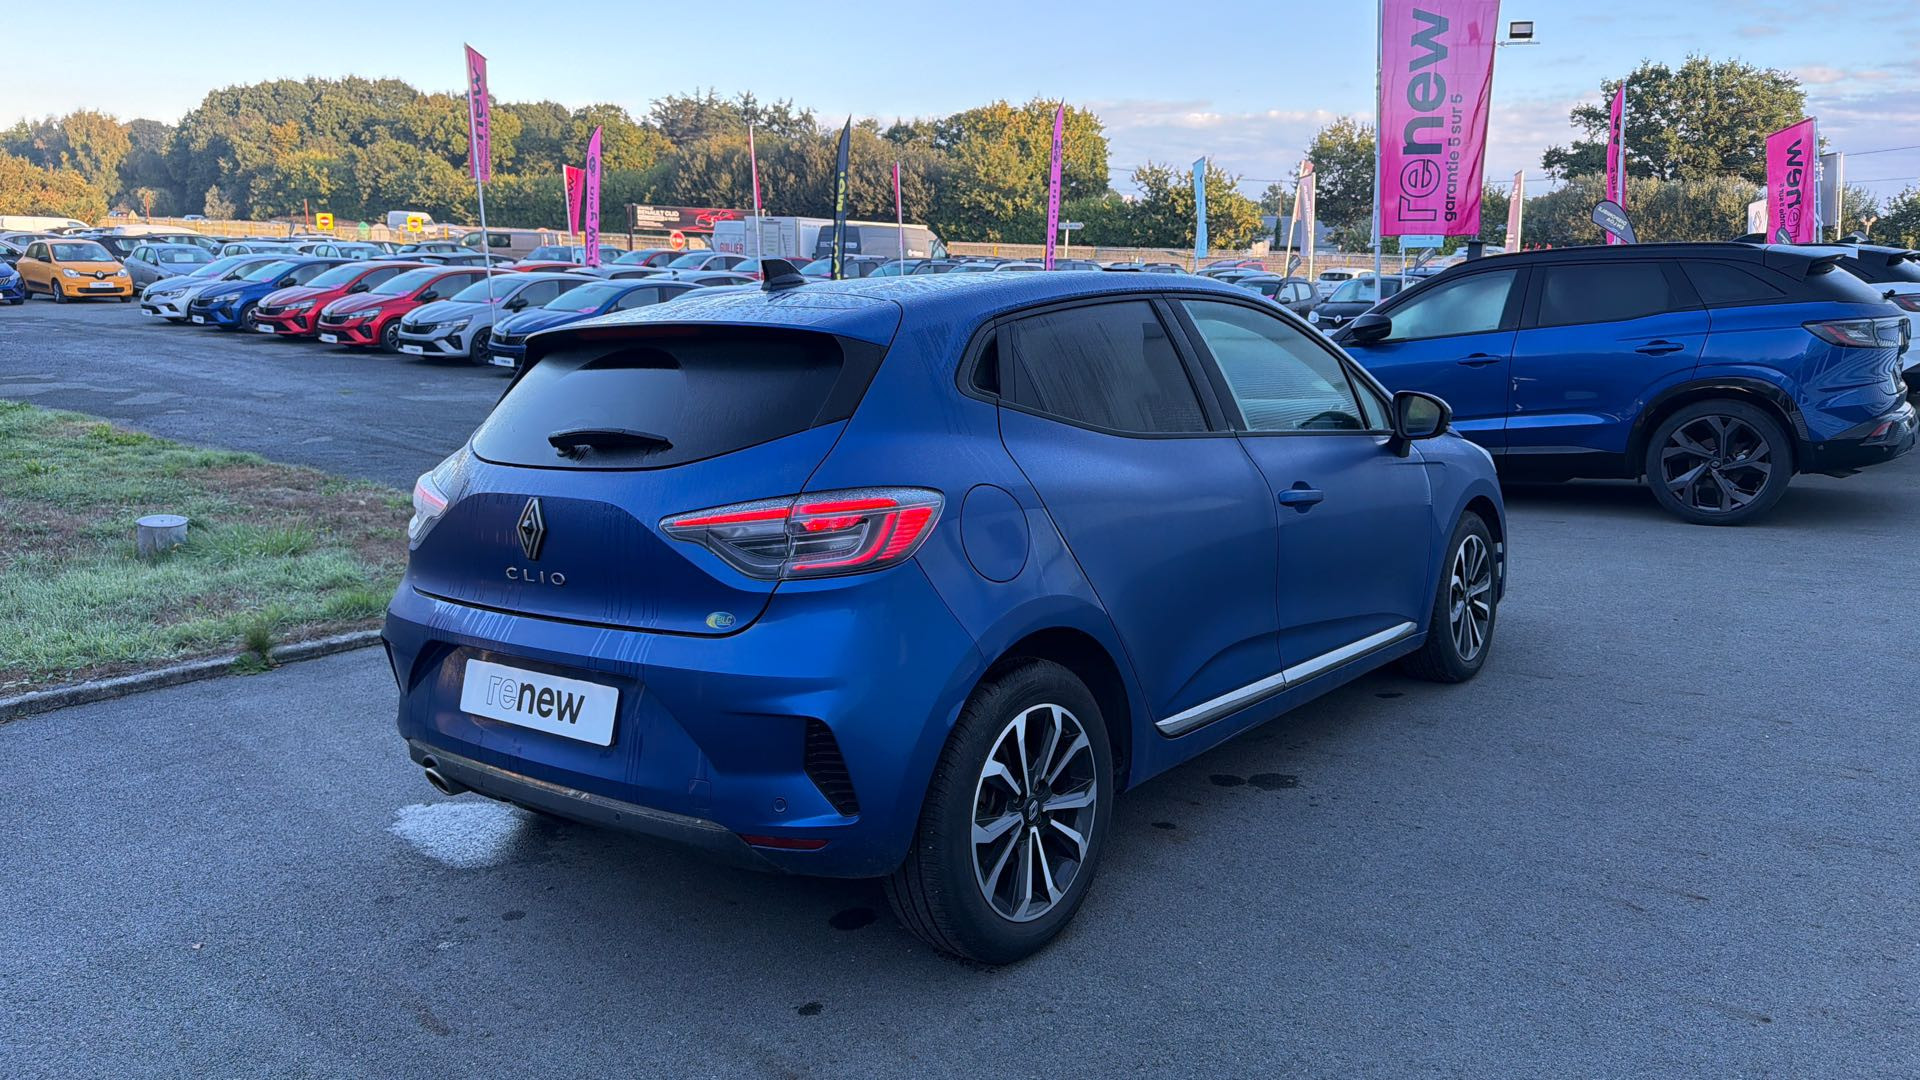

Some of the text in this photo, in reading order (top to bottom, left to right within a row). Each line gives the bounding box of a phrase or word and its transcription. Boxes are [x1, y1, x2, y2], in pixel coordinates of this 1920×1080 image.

[1398, 7, 1450, 222] renew
[1444, 93, 1463, 222] garantie 5 sur 5
[505, 567, 566, 586] CLIO
[486, 675, 586, 725] renew
